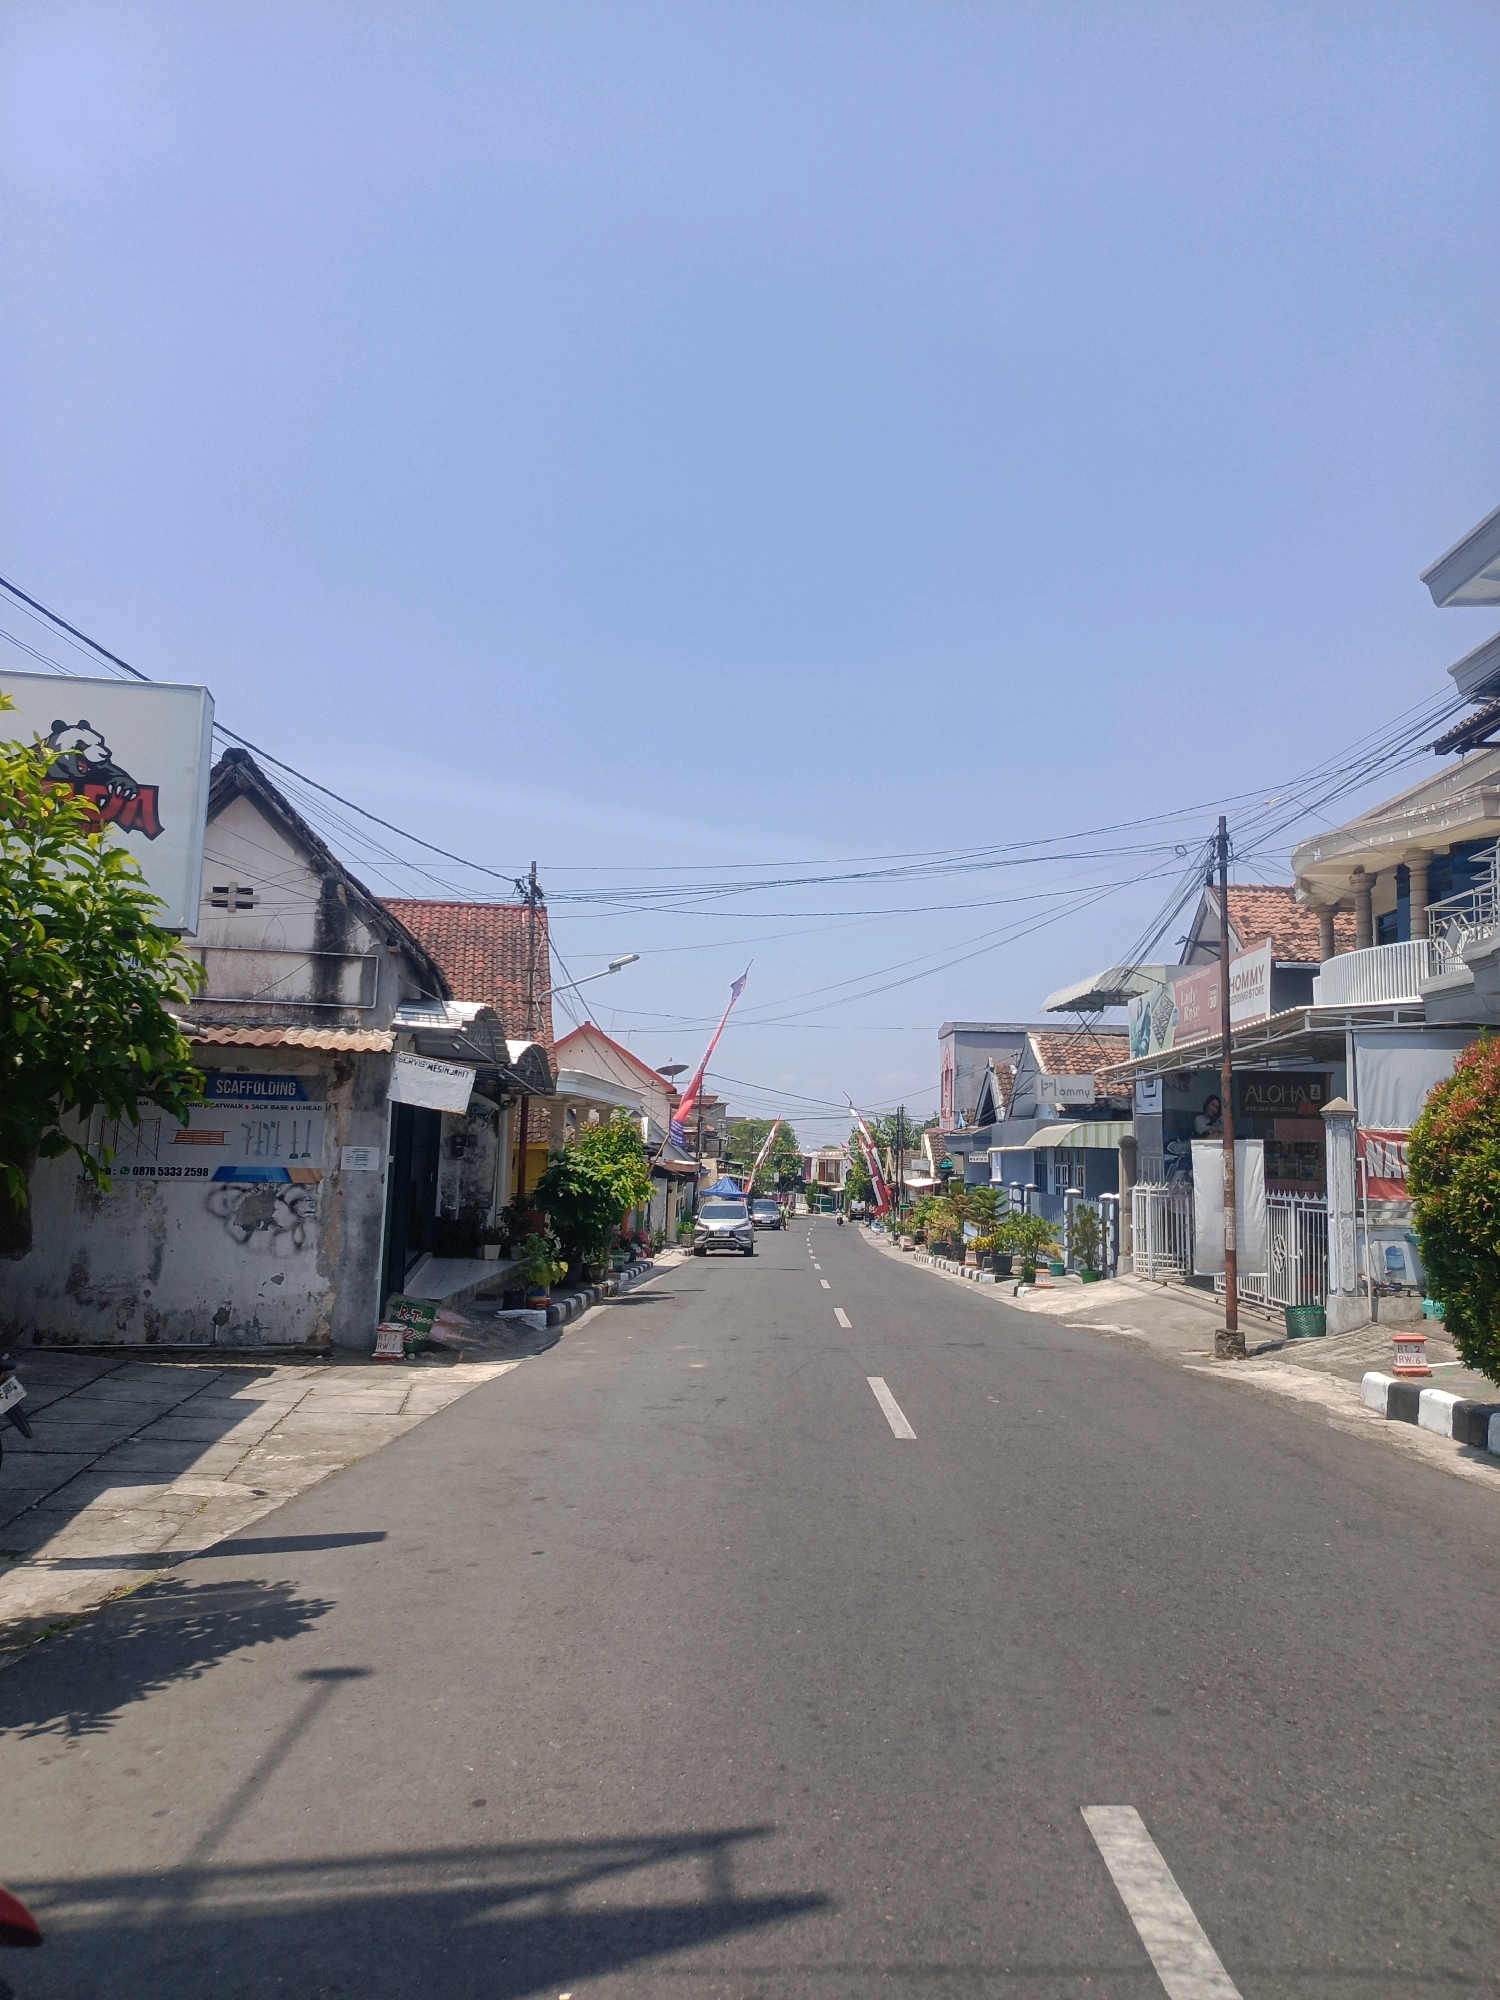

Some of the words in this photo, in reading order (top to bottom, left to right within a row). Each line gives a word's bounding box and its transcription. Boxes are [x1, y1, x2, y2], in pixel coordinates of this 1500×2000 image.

[1229, 963, 1265, 993] HOMMY
[1180, 986, 1196, 1007] Lady
[1248, 984, 1265, 999] STORE
[1183, 1005, 1200, 1022] Rose
[426, 1063, 449, 1075] MESIN
[216, 1079, 296, 1096] SCAFFOLDING
[1041, 1079, 1090, 1099] Hommy
[1245, 1085, 1307, 1103] ALOHA
[251, 1103, 269, 1111] JACK
[270, 1103, 289, 1111] BASE
[296, 1104, 323, 1112] U-HEAD
[132, 1165, 156, 1176] 0878
[157, 1166, 182, 1177] 5333
[184, 1166, 209, 1177] 2598
[378, 1333, 388, 1341] RT
[377, 1342, 389, 1350] RW
[1397, 1345, 1409, 1353] RT
[1414, 1345, 1421, 1353] 2
[1415, 1355, 1421, 1364] 6
